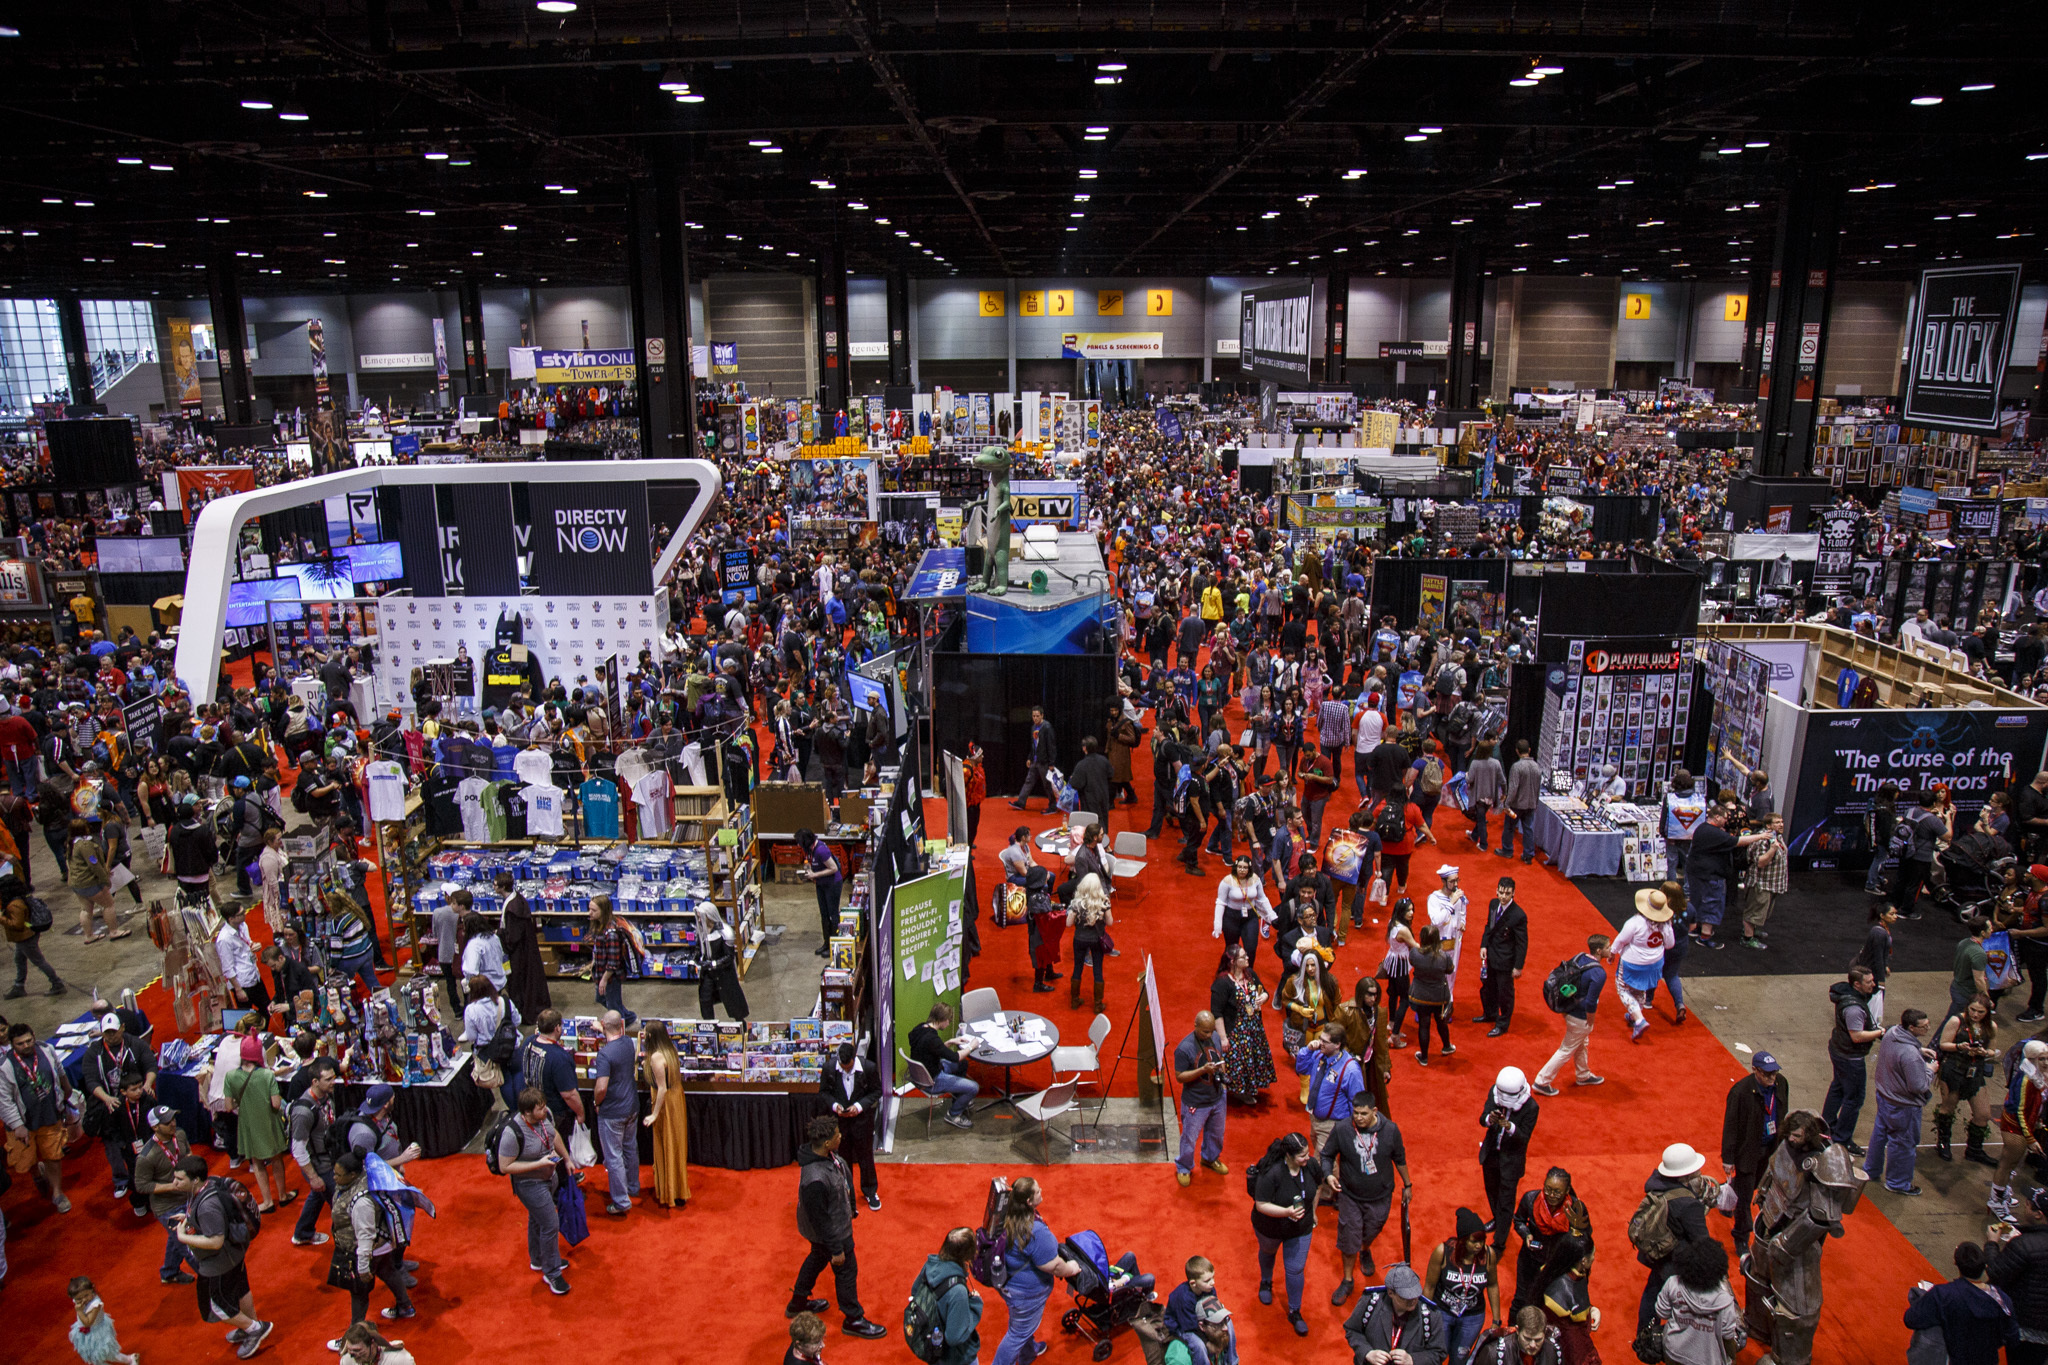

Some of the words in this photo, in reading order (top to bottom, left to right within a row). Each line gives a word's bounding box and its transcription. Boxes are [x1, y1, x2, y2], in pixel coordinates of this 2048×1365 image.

[1952, 296, 1976, 317] THE
[1919, 321, 2000, 384] BLOCK
[364, 356, 410, 365] Emergency
[542, 352, 596, 369] stylin
[598, 353, 634, 366] ONLI
[570, 368, 608, 380] TOWER
[190, 408, 201, 416] 500
[555, 509, 626, 526] DIRECTV
[1822, 510, 1860, 521] THIRTEENTH
[1960, 511, 1993, 524] LEAGU
[557, 526, 628, 553] NOW
[1827, 539, 1849, 547] FLOOR
[725, 551, 747, 560] CHECK
[726, 565, 749, 573] DIRECTV
[727, 571, 749, 583] NOW
[228, 600, 265, 609] ENTERTAINME
[1611, 653, 1649, 664] PLAYFUL
[128, 709, 141, 720] TAKE
[141, 702, 154, 713] YOUR
[129, 718, 145, 731] PHOTO
[145, 711, 158, 722] WITH
[1829, 717, 1862, 729] SUPER7
[136, 727, 147, 737] C2E2
[1887, 748, 1945, 768] Curse
[1952, 748, 1974, 766] of
[1980, 747, 2013, 766] the
[1854, 772, 1911, 792] Three
[901, 900, 932, 917] BECAUSE
[901, 915, 917, 927] FREE
[919, 908, 937, 920] WI-FI
[901, 915, 942, 937] SHOULDN'T
[901, 929, 931, 947] REQUIRE
[901, 940, 930, 956] RECEIPT.
[1446, 1270, 1488, 1284] DEADPOOL
